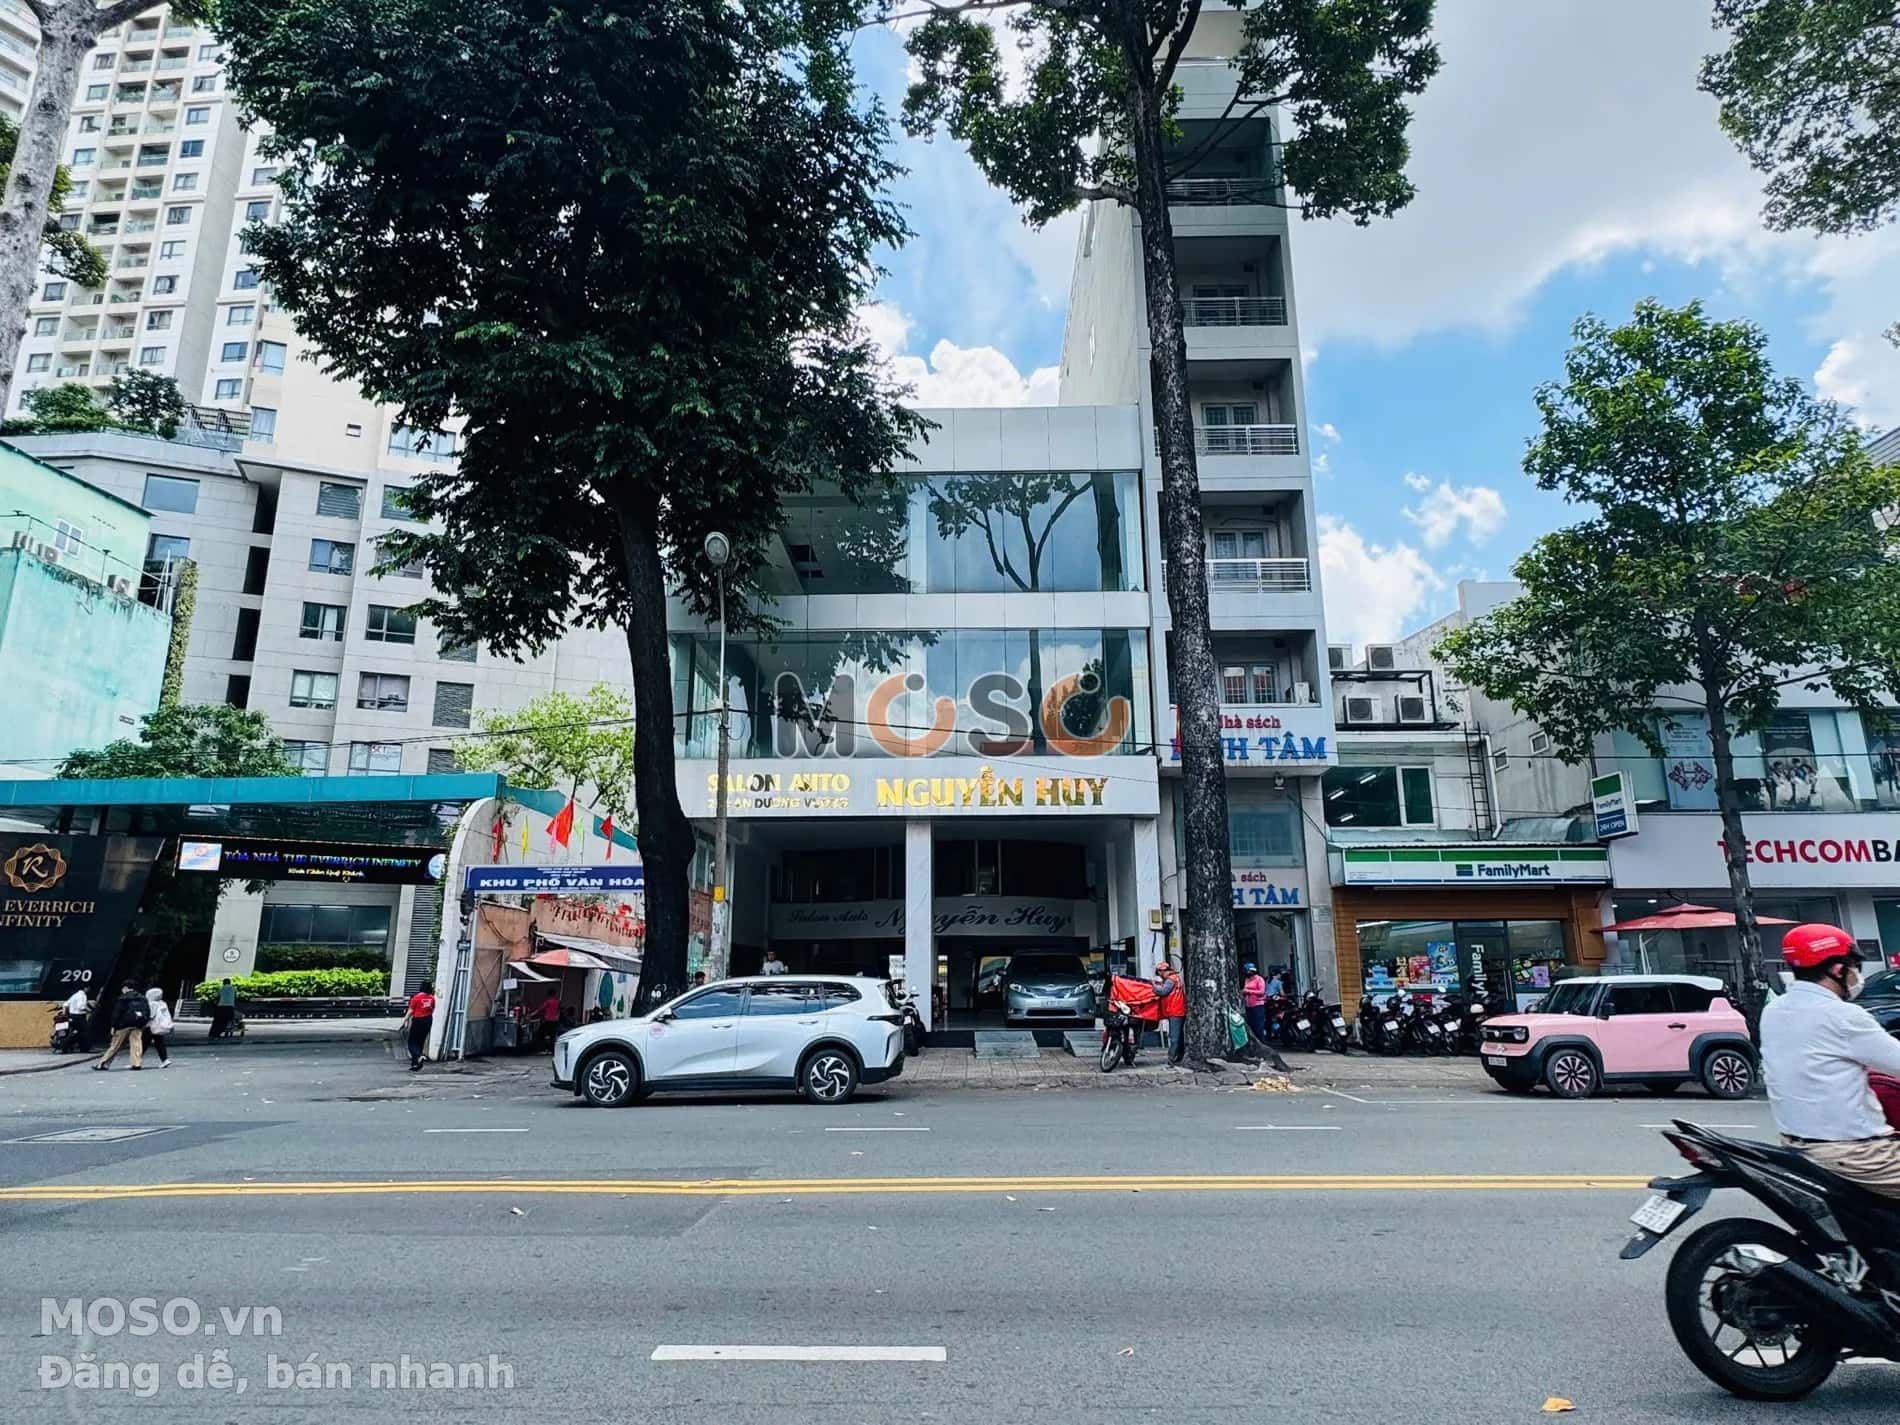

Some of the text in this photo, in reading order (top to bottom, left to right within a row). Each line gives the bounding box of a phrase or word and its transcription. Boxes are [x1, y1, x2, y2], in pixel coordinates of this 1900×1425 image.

[1246, 714, 1281, 728] sách
[1258, 731, 1327, 759] TÂM
[707, 773, 850, 793] SALON AUTO
[876, 765, 1108, 807] NGUYỄN HUY
[1478, 863, 1550, 877] FamilyMart
[480, 879, 517, 887] KHU
[566, 876, 603, 887] VĂN
[1249, 884, 1300, 905] TÂM
[4, 900, 96, 913] EVERRICH
[1004, 904, 1074, 933] Huy
[60, 969, 92, 982] 290
